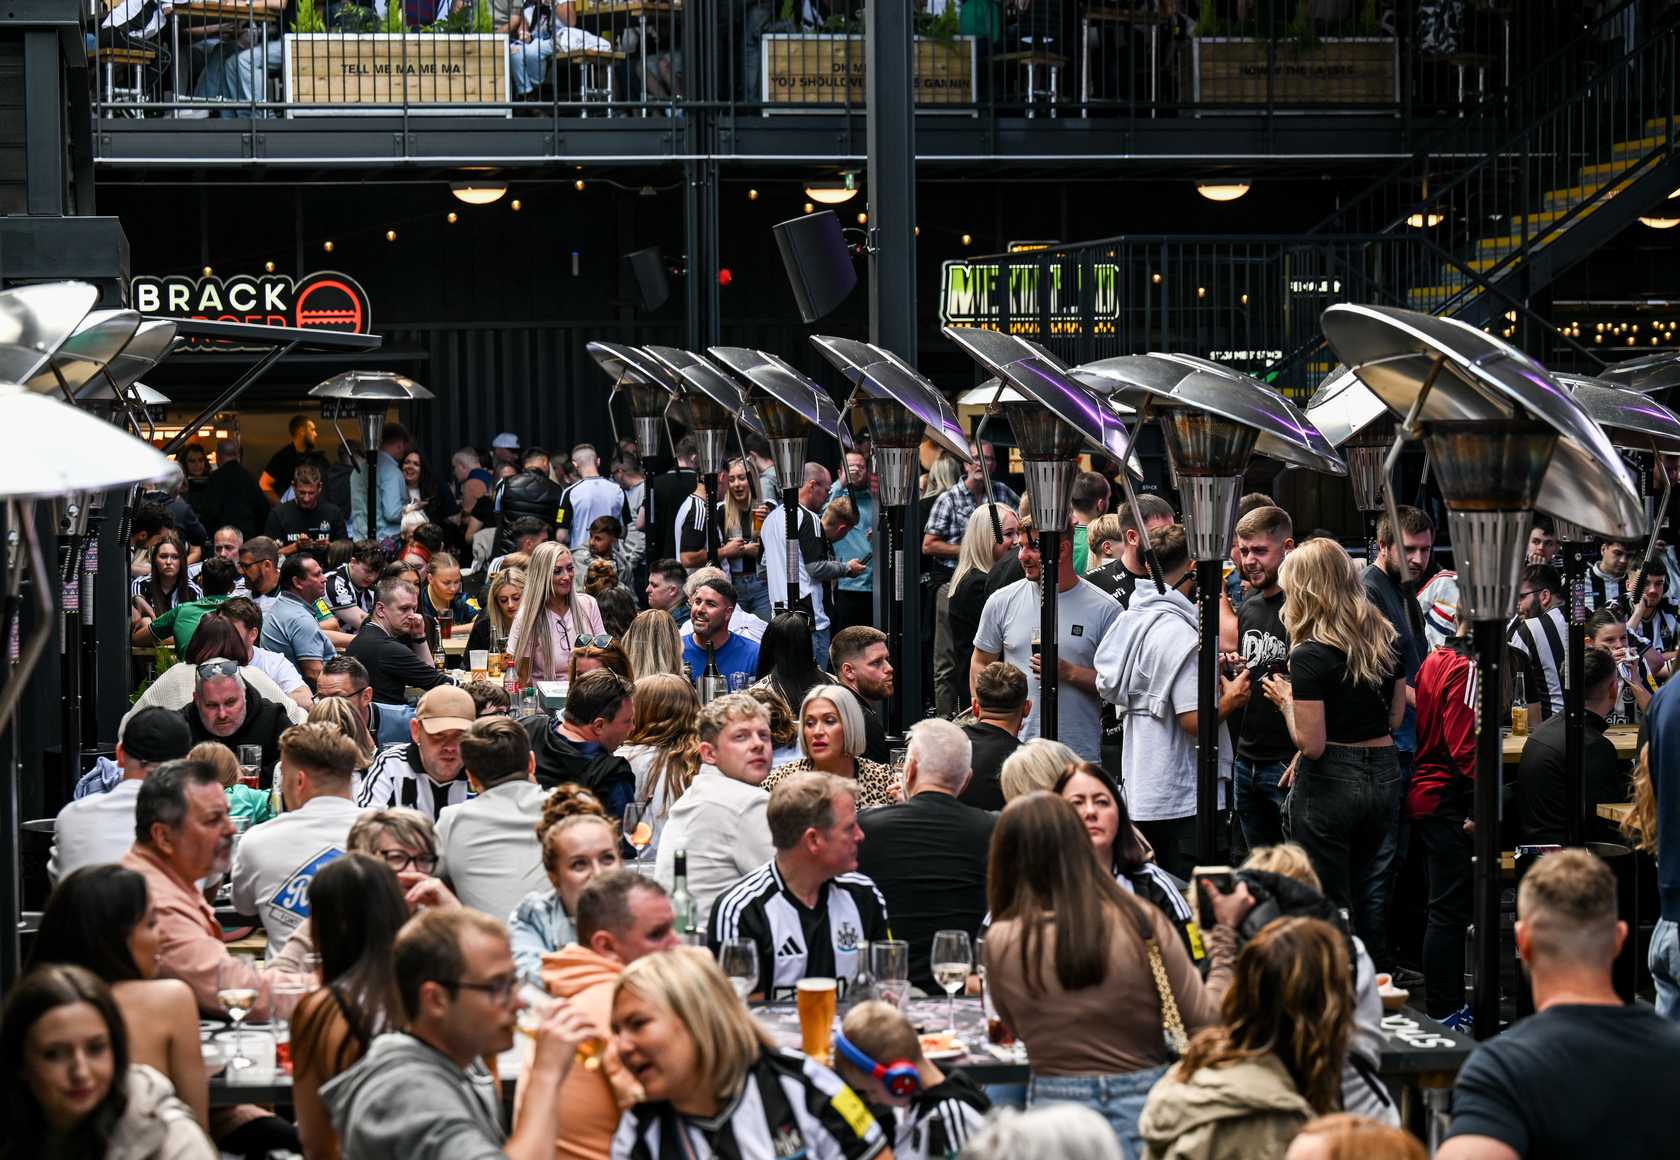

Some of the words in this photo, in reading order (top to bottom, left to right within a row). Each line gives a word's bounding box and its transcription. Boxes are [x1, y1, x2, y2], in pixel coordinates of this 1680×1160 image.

[341, 64, 369, 74] TELL
[373, 64, 392, 74] ME
[419, 64, 437, 74] ME
[441, 64, 461, 74] MA
[771, 77, 795, 88] YOU
[138, 283, 287, 312] BRACK
[1605, 713, 1629, 726] ela
